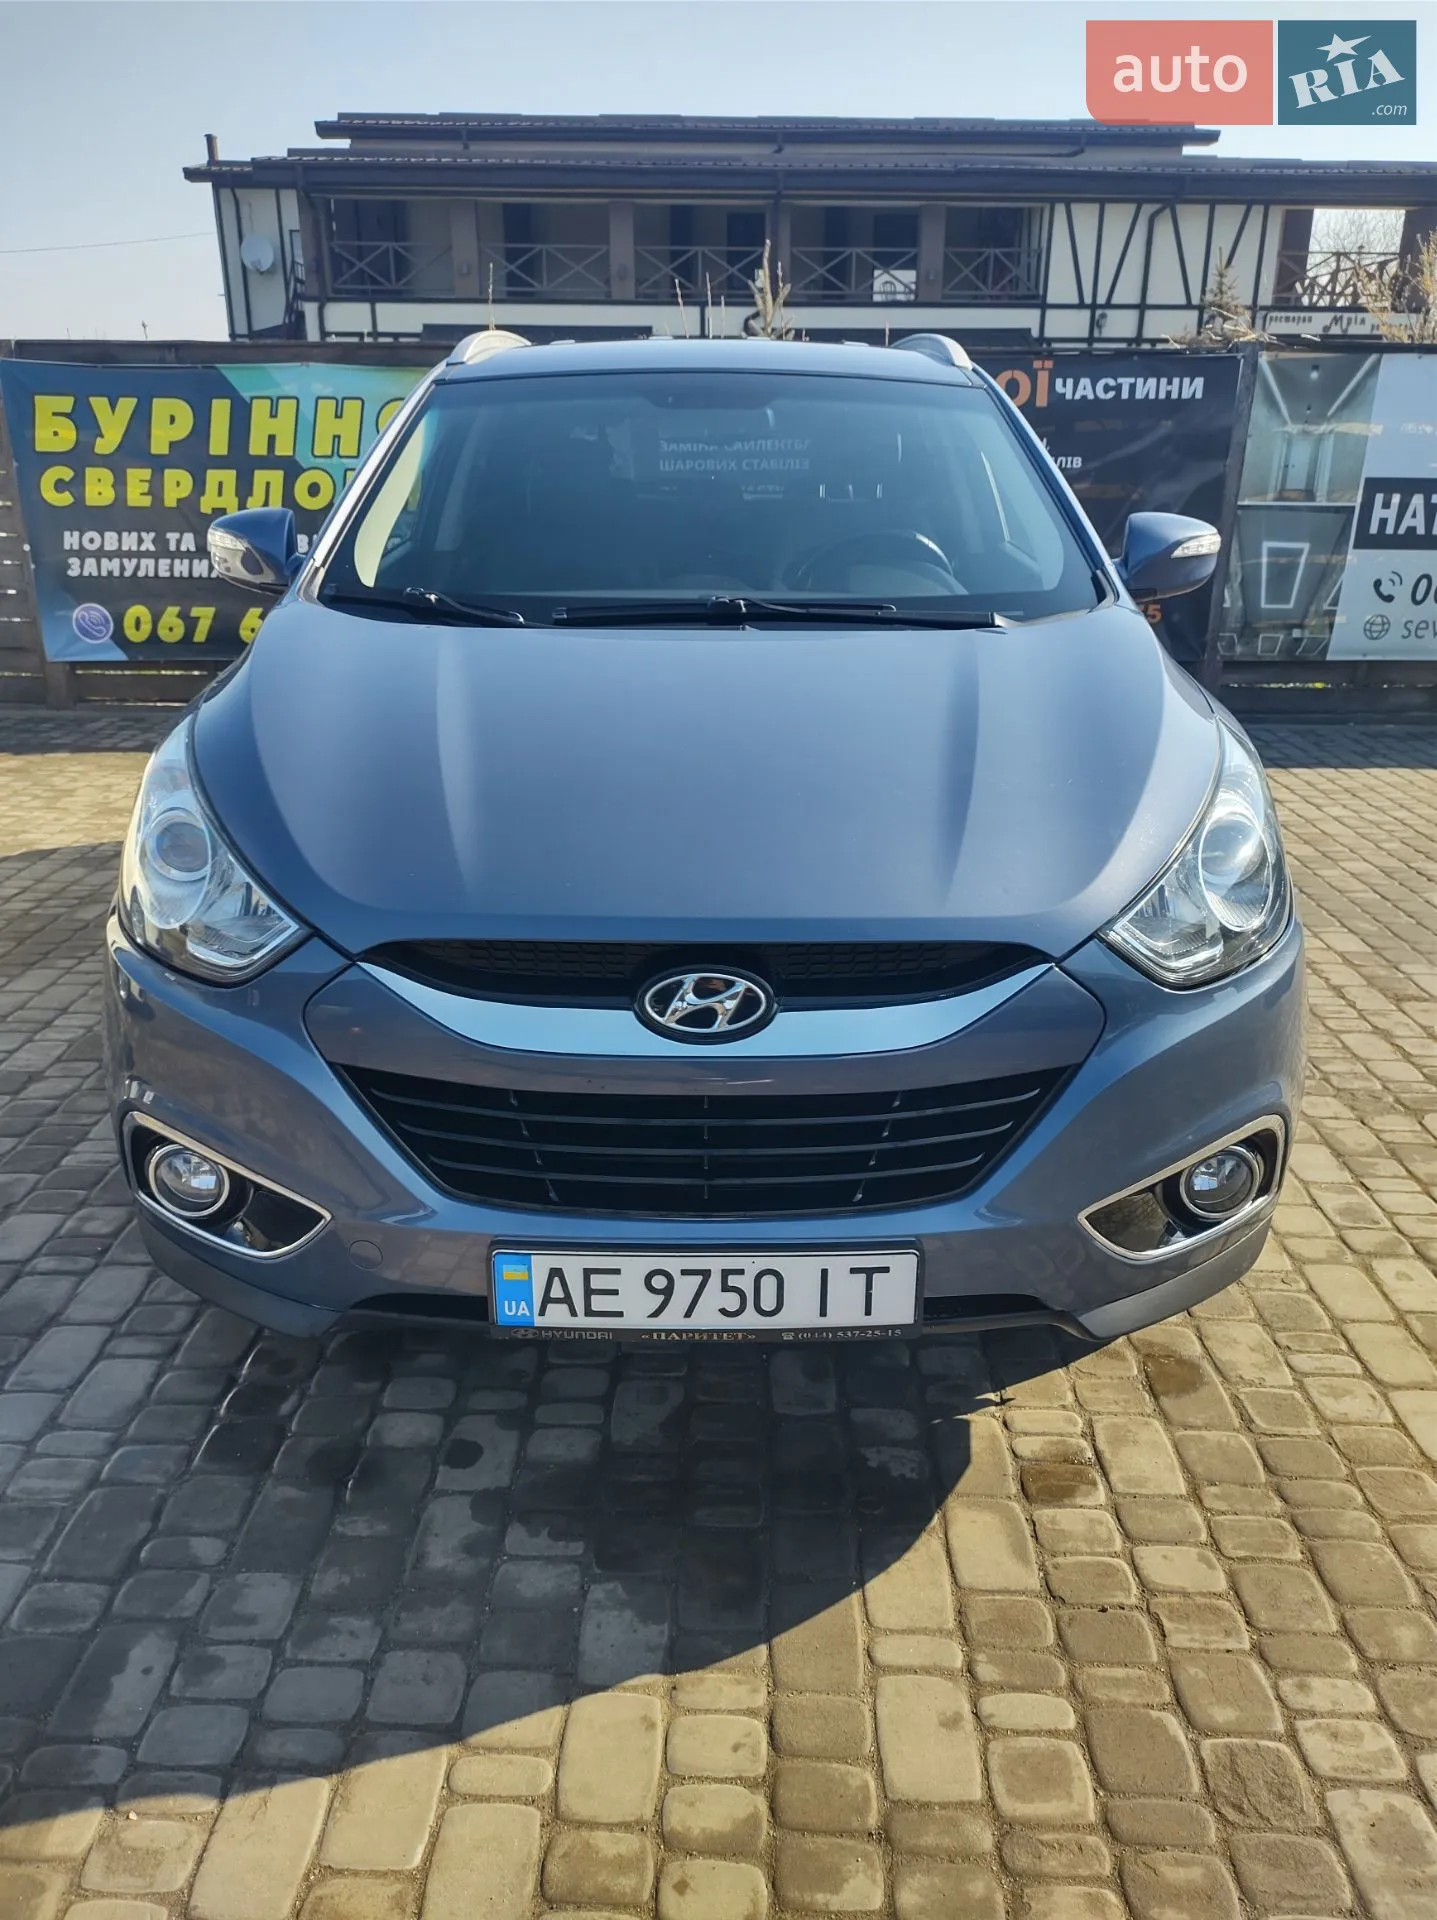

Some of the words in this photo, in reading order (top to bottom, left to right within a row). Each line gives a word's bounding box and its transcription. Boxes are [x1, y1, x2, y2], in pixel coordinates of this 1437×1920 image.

[1054, 376, 1205, 401] ЧАСТИНИ
[39, 465, 355, 516] СВЕРДЛО
[1369, 493, 1437, 535] НА
[63, 530, 156, 552] НОВИХ
[165, 532, 196, 552] ТА
[1411, 573, 1437, 606] 0
[123, 605, 216, 643] 067
[1401, 619, 1437, 639] se
[538, 1267, 625, 1318] AE
[643, 1268, 785, 1318] 9750
[819, 1266, 891, 1318] IT
[504, 1301, 530, 1316] UA
[541, 1331, 613, 1340] HYUNDAI
